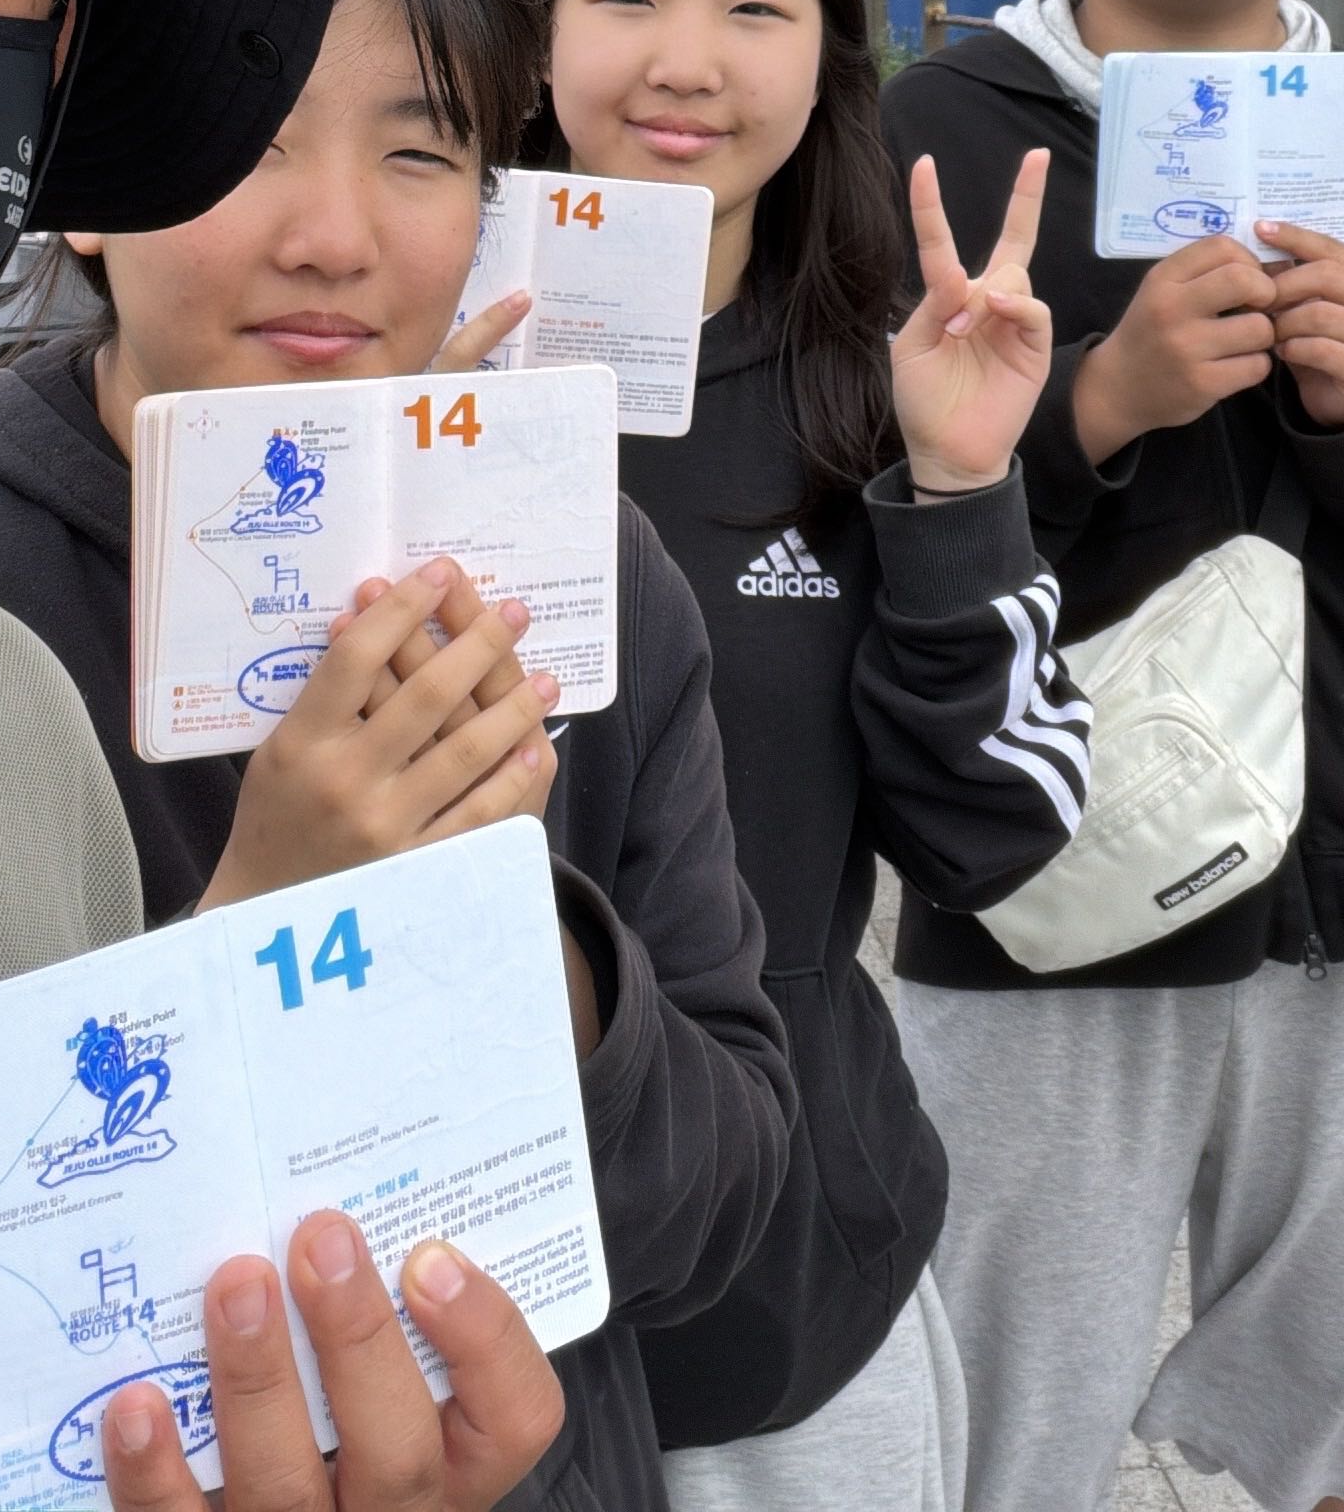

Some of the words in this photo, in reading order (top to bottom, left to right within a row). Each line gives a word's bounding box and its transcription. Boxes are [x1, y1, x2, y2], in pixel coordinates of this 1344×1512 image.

[1259, 64, 1309, 98] 14
[549, 187, 605, 231] 14
[402, 391, 484, 451] 14
[737, 570, 840, 599] adidas
[286, 592, 309, 613] 14
[1161, 885, 1191, 908] new
[1188, 851, 1242, 893] balance
[255, 907, 373, 1012] 14
[152, 1007, 177, 1024] Point
[62, 1160, 86, 1175] JEJU
[87, 1153, 112, 1168] OLLE
[112, 1144, 145, 1162] ROUTE
[27, 1211, 56, 1226] Cactus
[512, 1253, 546, 1277] peaceful
[546, 1245, 569, 1261] fields
[569, 1235, 585, 1252] and
[541, 1257, 570, 1278] coastal
[571, 1248, 587, 1264] trail
[555, 1263, 590, 1286] constant
[530, 1295, 555, 1315] plants
[556, 1277, 593, 1301] alongside
[69, 1319, 122, 1345] ROUTE
[122, 1297, 158, 1329] 14
[173, 1373, 210, 1392] Startin
